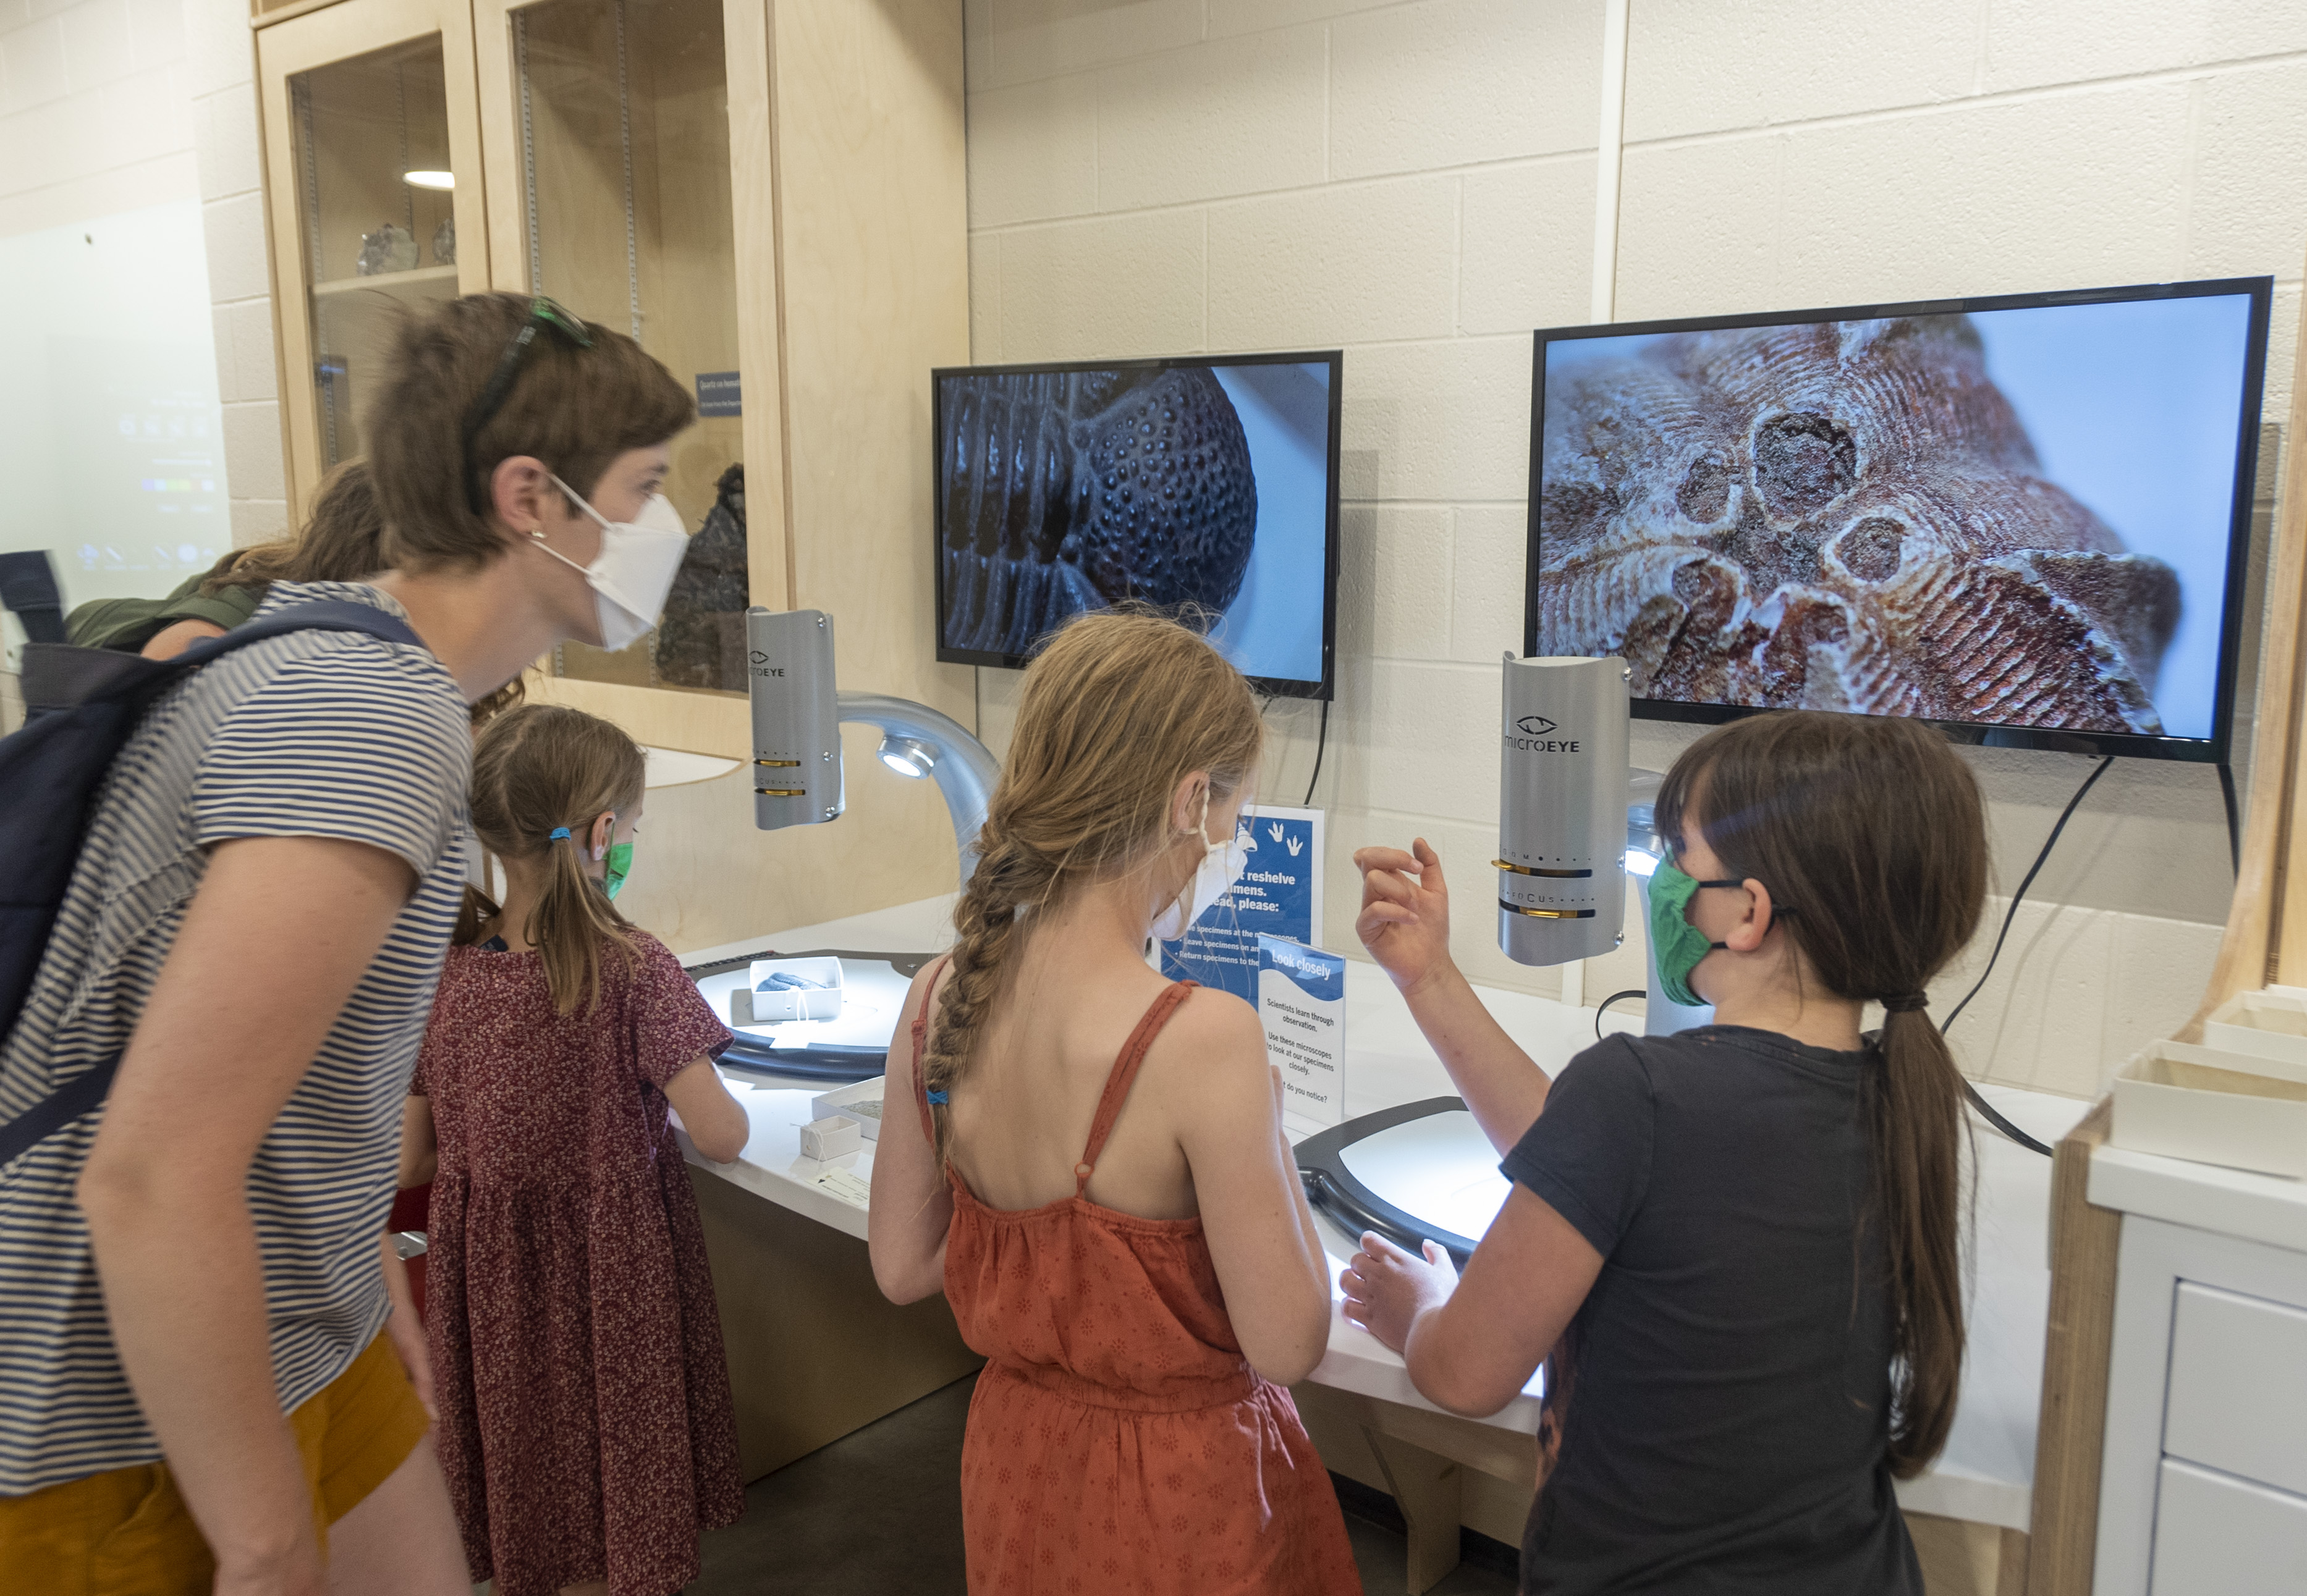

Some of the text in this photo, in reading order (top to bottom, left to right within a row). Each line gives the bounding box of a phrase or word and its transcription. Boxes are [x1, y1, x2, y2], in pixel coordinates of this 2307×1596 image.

[1500, 847, 1529, 859] OOM
[1247, 871, 1295, 885] reshelve
[1238, 898, 1279, 912] please:
[1196, 926, 1232, 936] specimens
[1184, 938, 1202, 946] Leave
[1204, 940, 1239, 950] specimens
[1179, 950, 1201, 960] Return
[1203, 953, 1238, 963] specimens
[1239, 957, 1247, 965] to
[1272, 948, 1331, 981] Look closely
[1267, 998, 1334, 1027] Scientists learn through
[1282, 1015, 1318, 1032] observation.
[1268, 1031, 1332, 1060] Use these microscopes
[1273, 1044, 1285, 1055] look
[1285, 1050, 1292, 1058] at
[1293, 1052, 1303, 1061] our
[1303, 1056, 1334, 1072] specimens
[1289, 1062, 1310, 1076] closely.
[1287, 1083, 1294, 1092] do
[1295, 1087, 1305, 1096] you
[1306, 1091, 1328, 1104] notice?
